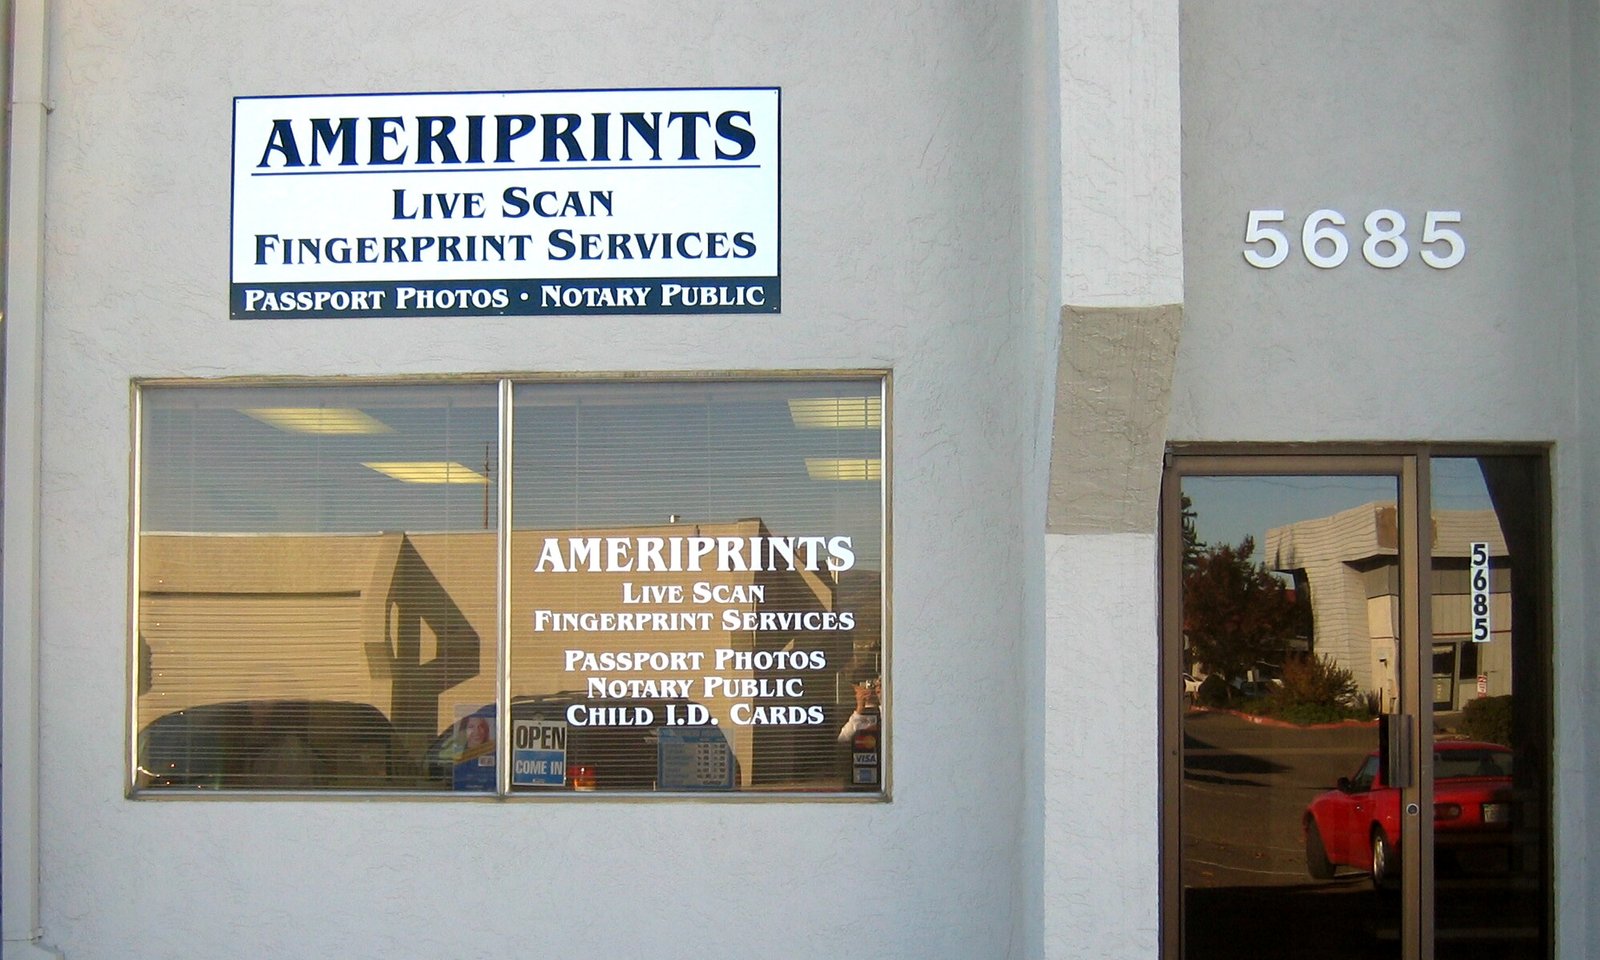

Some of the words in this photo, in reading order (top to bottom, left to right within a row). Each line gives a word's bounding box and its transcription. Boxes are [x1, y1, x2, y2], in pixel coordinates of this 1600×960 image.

[256, 110, 757, 168] AMERIPRINTS
[392, 188, 486, 220] LIVE
[502, 186, 614, 219] SCAN
[254, 233, 533, 265] FINGERPRINT
[547, 228, 758, 261] SERVICES
[1243, 208, 1466, 269] 5685
[244, 289, 386, 312] PASSPORT
[396, 286, 509, 310] PHOTOS
[540, 284, 652, 308] NOTARY
[660, 282, 766, 307] PUBLIC
[534, 536, 856, 573] AMERIPRINTS
[622, 582, 684, 604] LIVE
[692, 582, 765, 604] SCAN
[1472, 543, 1488, 641] 5685
[534, 610, 714, 632] FINGERPRINT
[721, 609, 855, 631] SERVICES
[564, 650, 705, 671] PASSPORT
[715, 648, 826, 670] PHOTOS
[587, 677, 694, 698] NOTARY
[703, 676, 804, 698] PUBLIC
[566, 703, 654, 726] CHILD
[665, 704, 719, 726] I.D.
[730, 703, 825, 725] CARDS
[516, 725, 565, 750] OPEN
[515, 760, 547, 774] COME
[550, 761, 563, 774] IN
